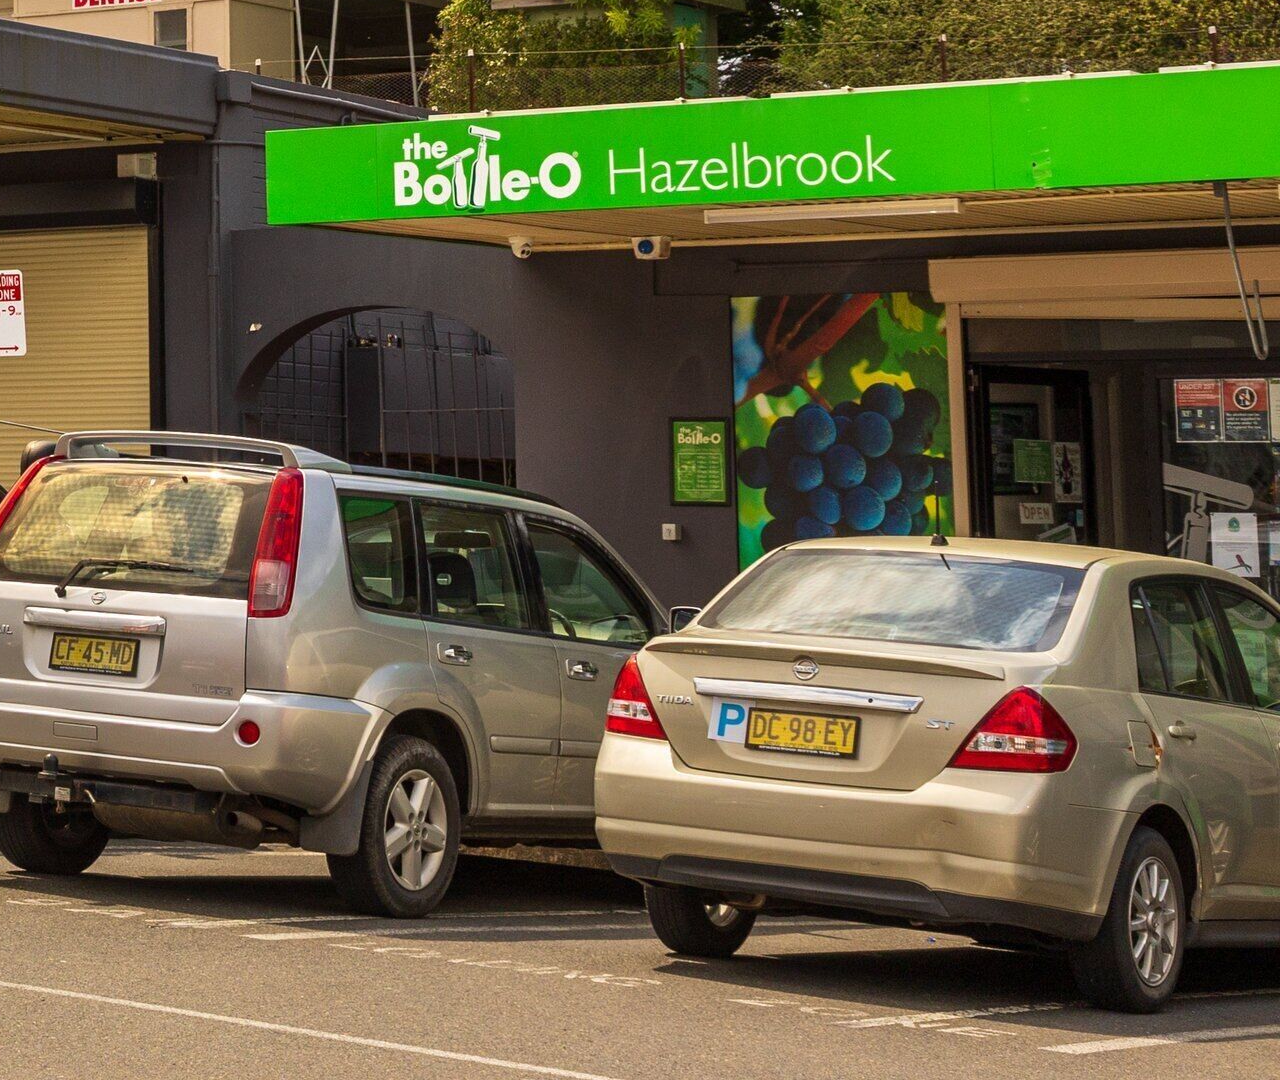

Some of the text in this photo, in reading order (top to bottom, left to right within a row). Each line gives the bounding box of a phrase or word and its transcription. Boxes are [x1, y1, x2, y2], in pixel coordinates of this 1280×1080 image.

[402, 132, 449, 161] the
[608, 134, 896, 195] Hazelbrook
[657, 694, 693, 706] TIIDA
[717, 702, 745, 737] P
